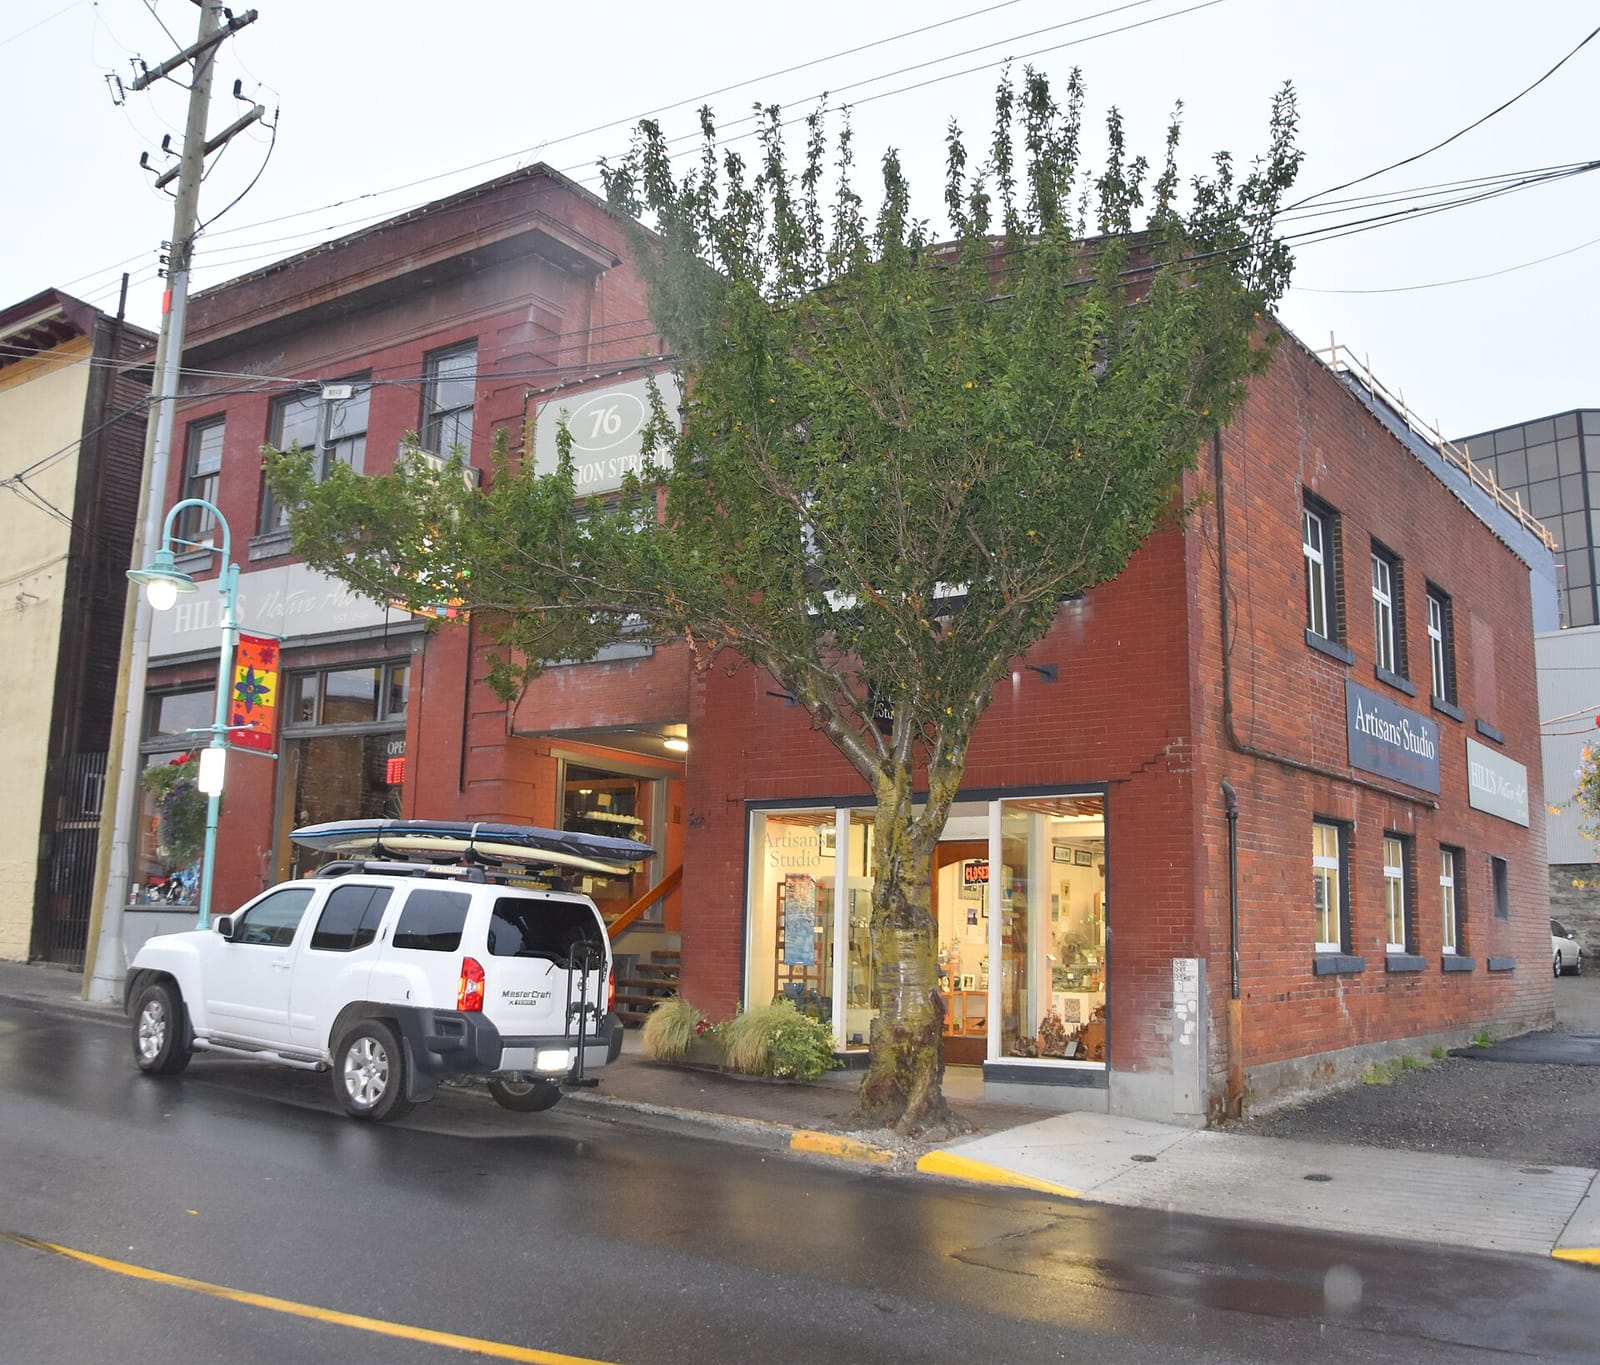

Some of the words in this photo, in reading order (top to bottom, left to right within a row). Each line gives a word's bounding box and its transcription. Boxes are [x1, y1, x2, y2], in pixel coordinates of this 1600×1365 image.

[589, 404, 621, 438] 76
[1403, 718, 1435, 760] Studio
[769, 849, 821, 868] Studio
[965, 865, 989, 881] CLOSE
